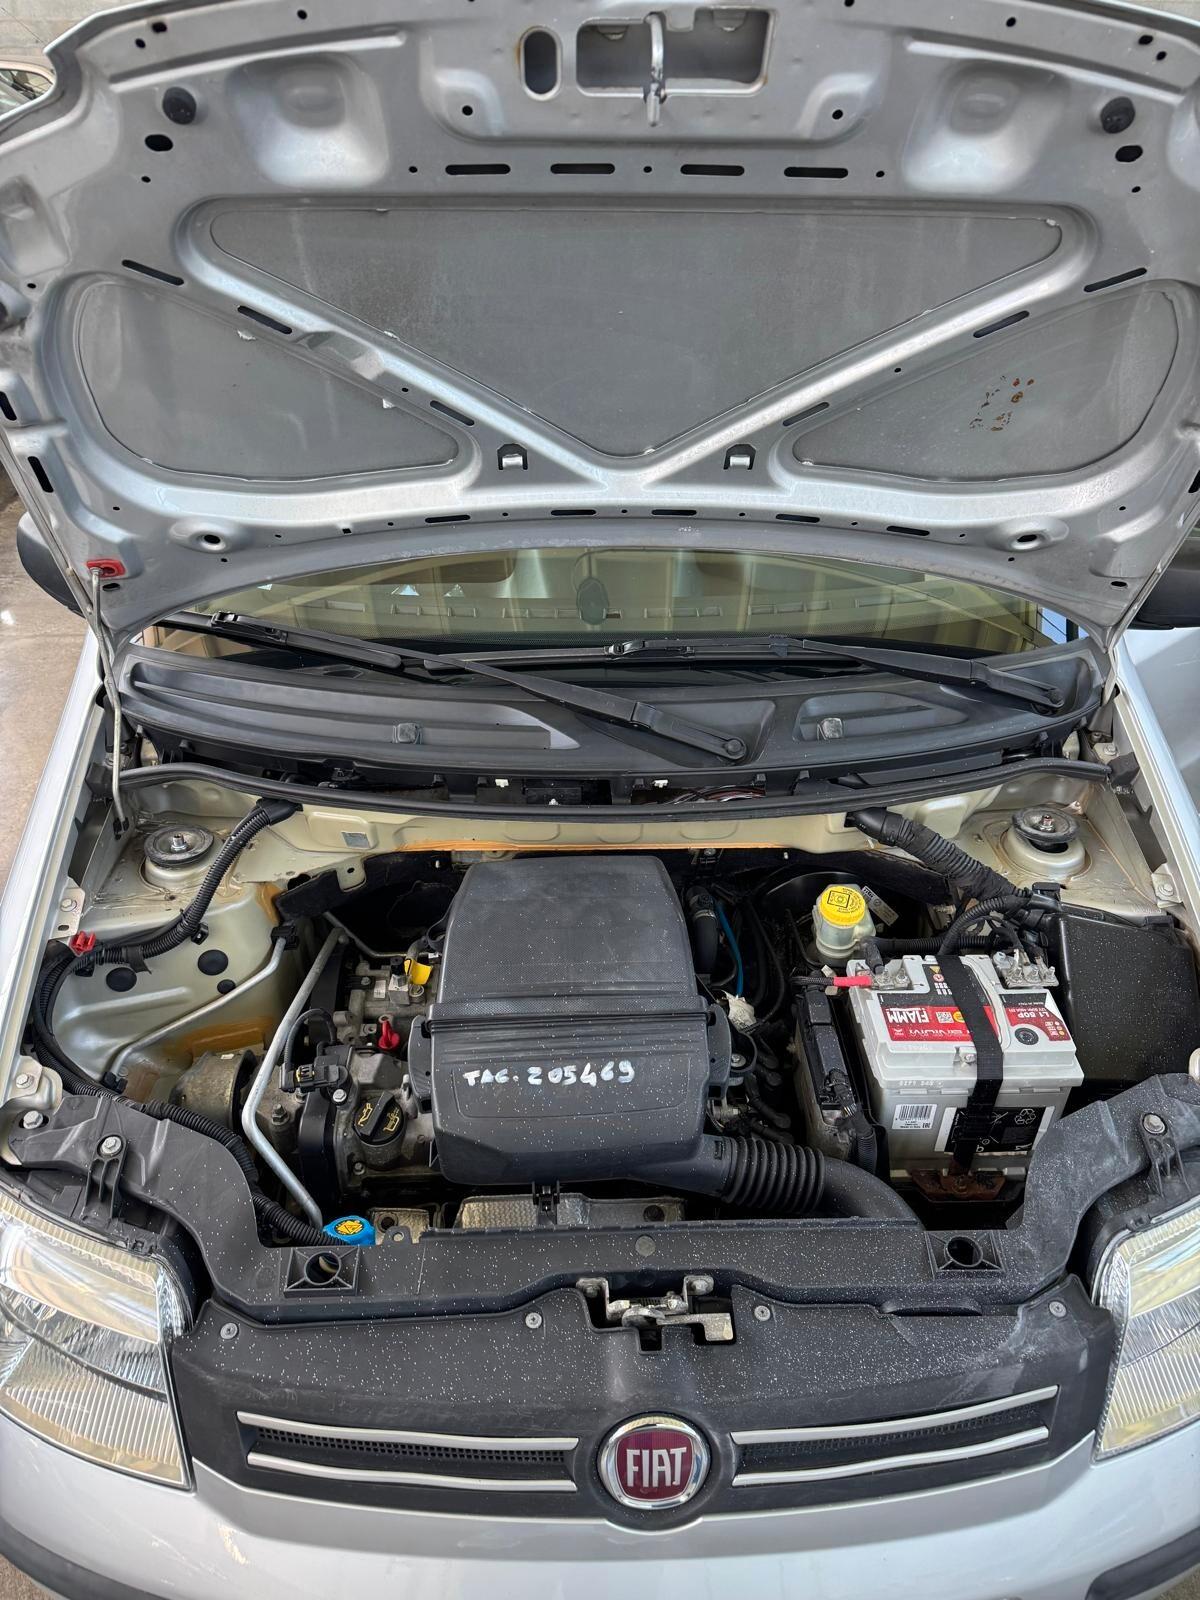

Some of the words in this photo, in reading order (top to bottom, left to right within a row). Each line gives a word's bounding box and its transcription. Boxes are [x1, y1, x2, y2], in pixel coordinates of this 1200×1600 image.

[886, 1009, 930, 1024] FIAMM
[527, 1059, 636, 1088] 205469
[626, 1446, 687, 1488] FIAT
